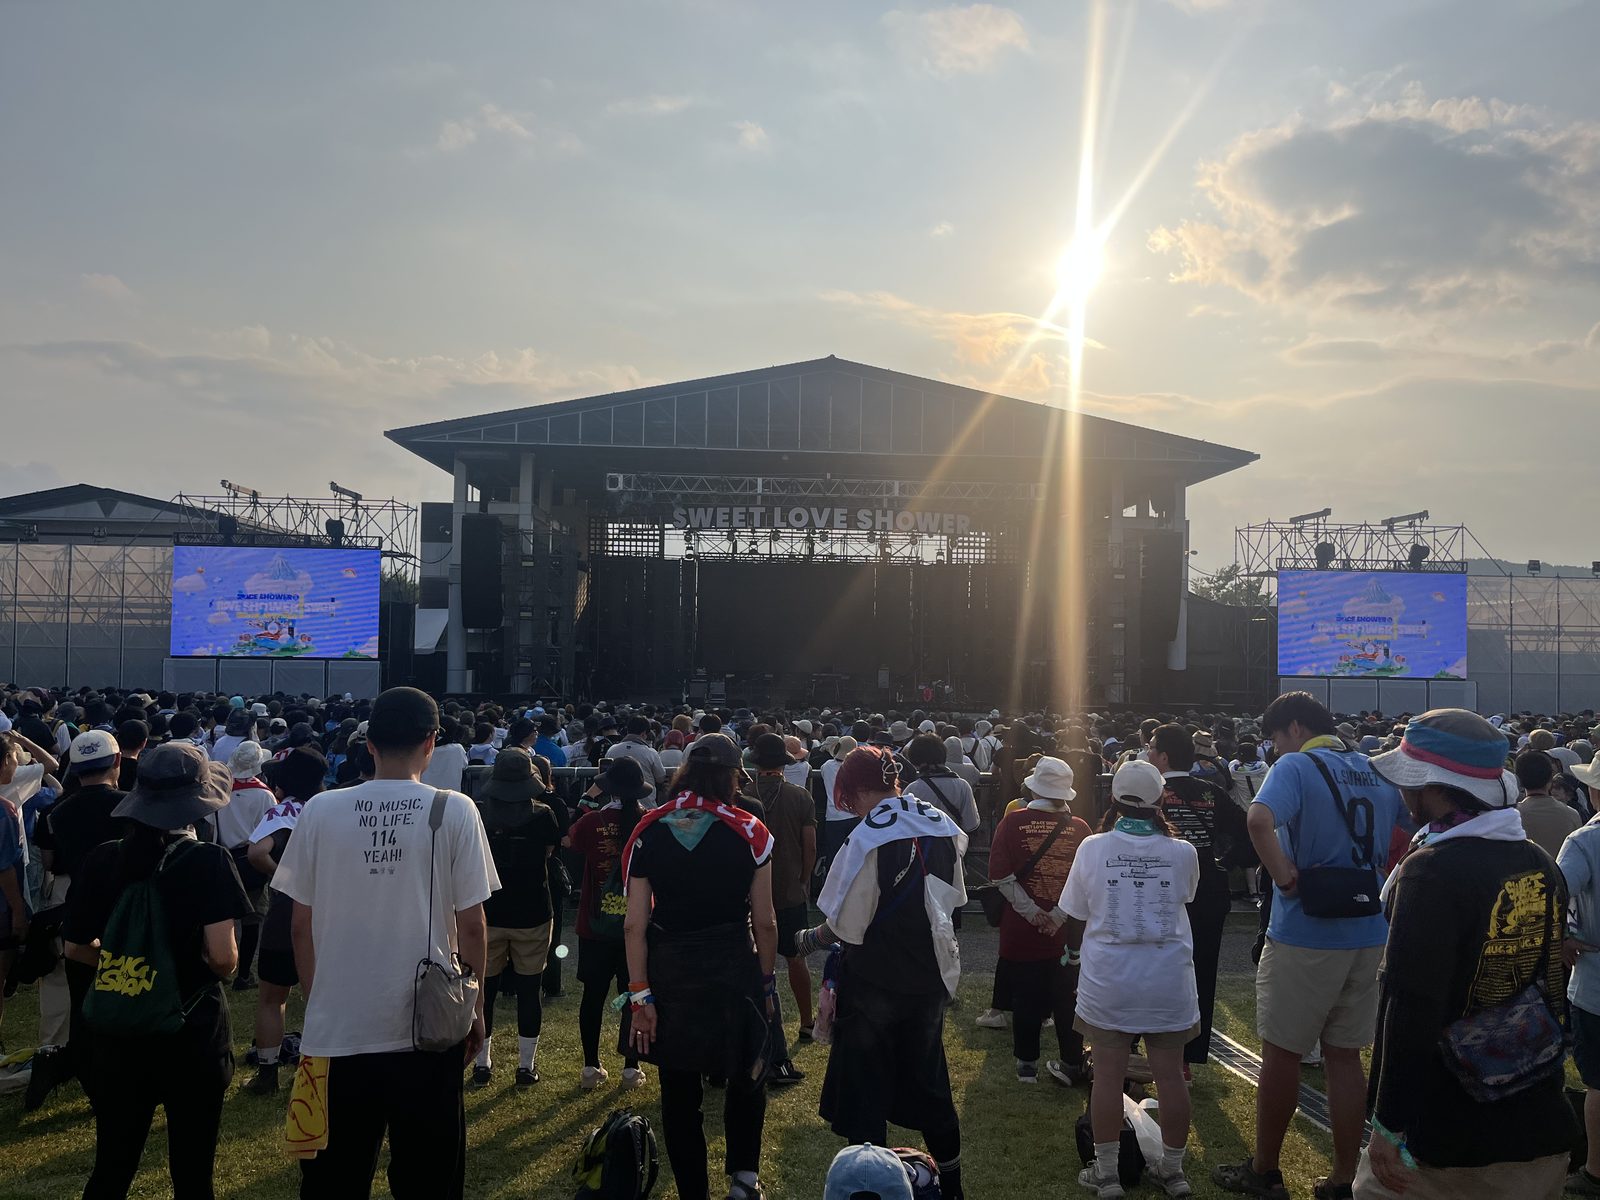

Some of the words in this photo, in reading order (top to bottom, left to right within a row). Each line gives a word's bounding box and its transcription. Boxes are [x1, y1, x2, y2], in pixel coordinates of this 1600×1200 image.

[672, 506, 766, 529] SWEET
[774, 507, 848, 528] LOVE
[857, 508, 970, 536] SHOWER
[355, 800, 373, 812] NO
[379, 798, 423, 812] MUSIC,
[359, 815, 378, 827] NO
[383, 813, 414, 827] LIFE.
[372, 829, 397, 847] 114
[1347, 796, 1375, 868] 9
[364, 848, 402, 863] YEAH!
